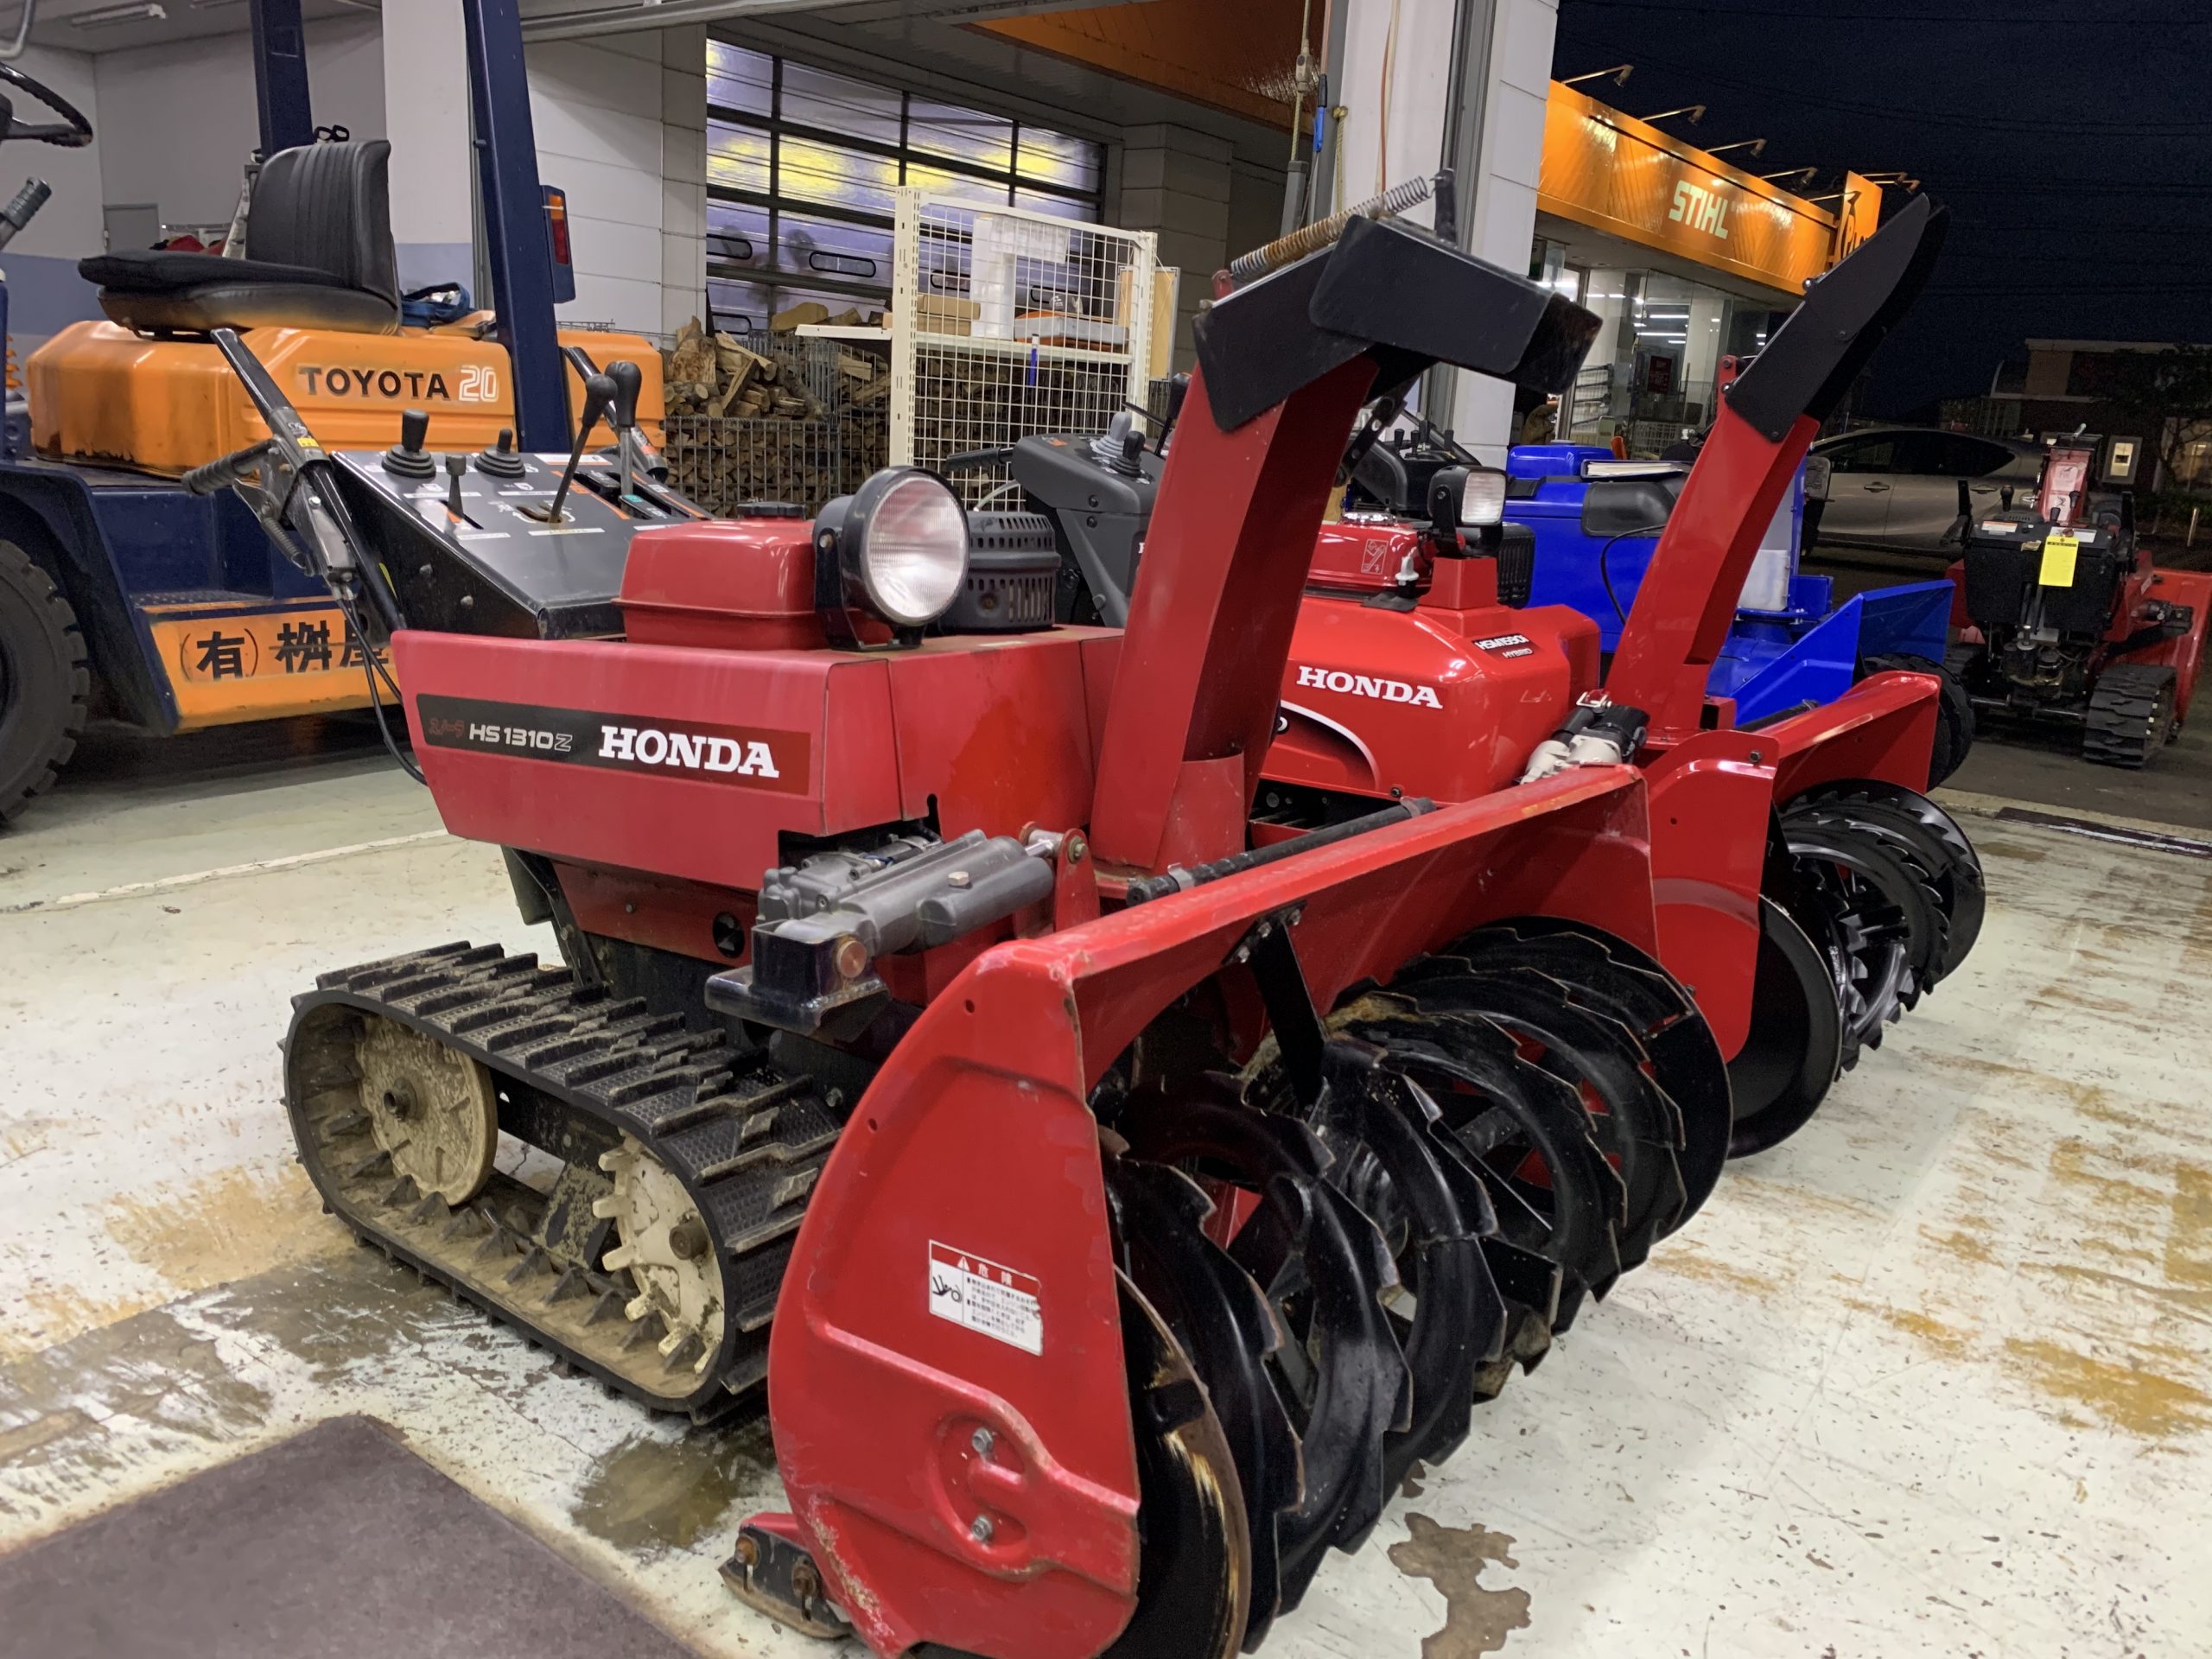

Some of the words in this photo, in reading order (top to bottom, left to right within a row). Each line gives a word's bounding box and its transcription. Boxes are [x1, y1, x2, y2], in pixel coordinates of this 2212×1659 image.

[1669, 180, 1728, 239] STIHL
[299, 366, 450, 401] TOYOTA
[459, 365, 499, 403] 20
[1296, 665, 1443, 709] HONDA
[598, 725, 779, 778] HONDA
